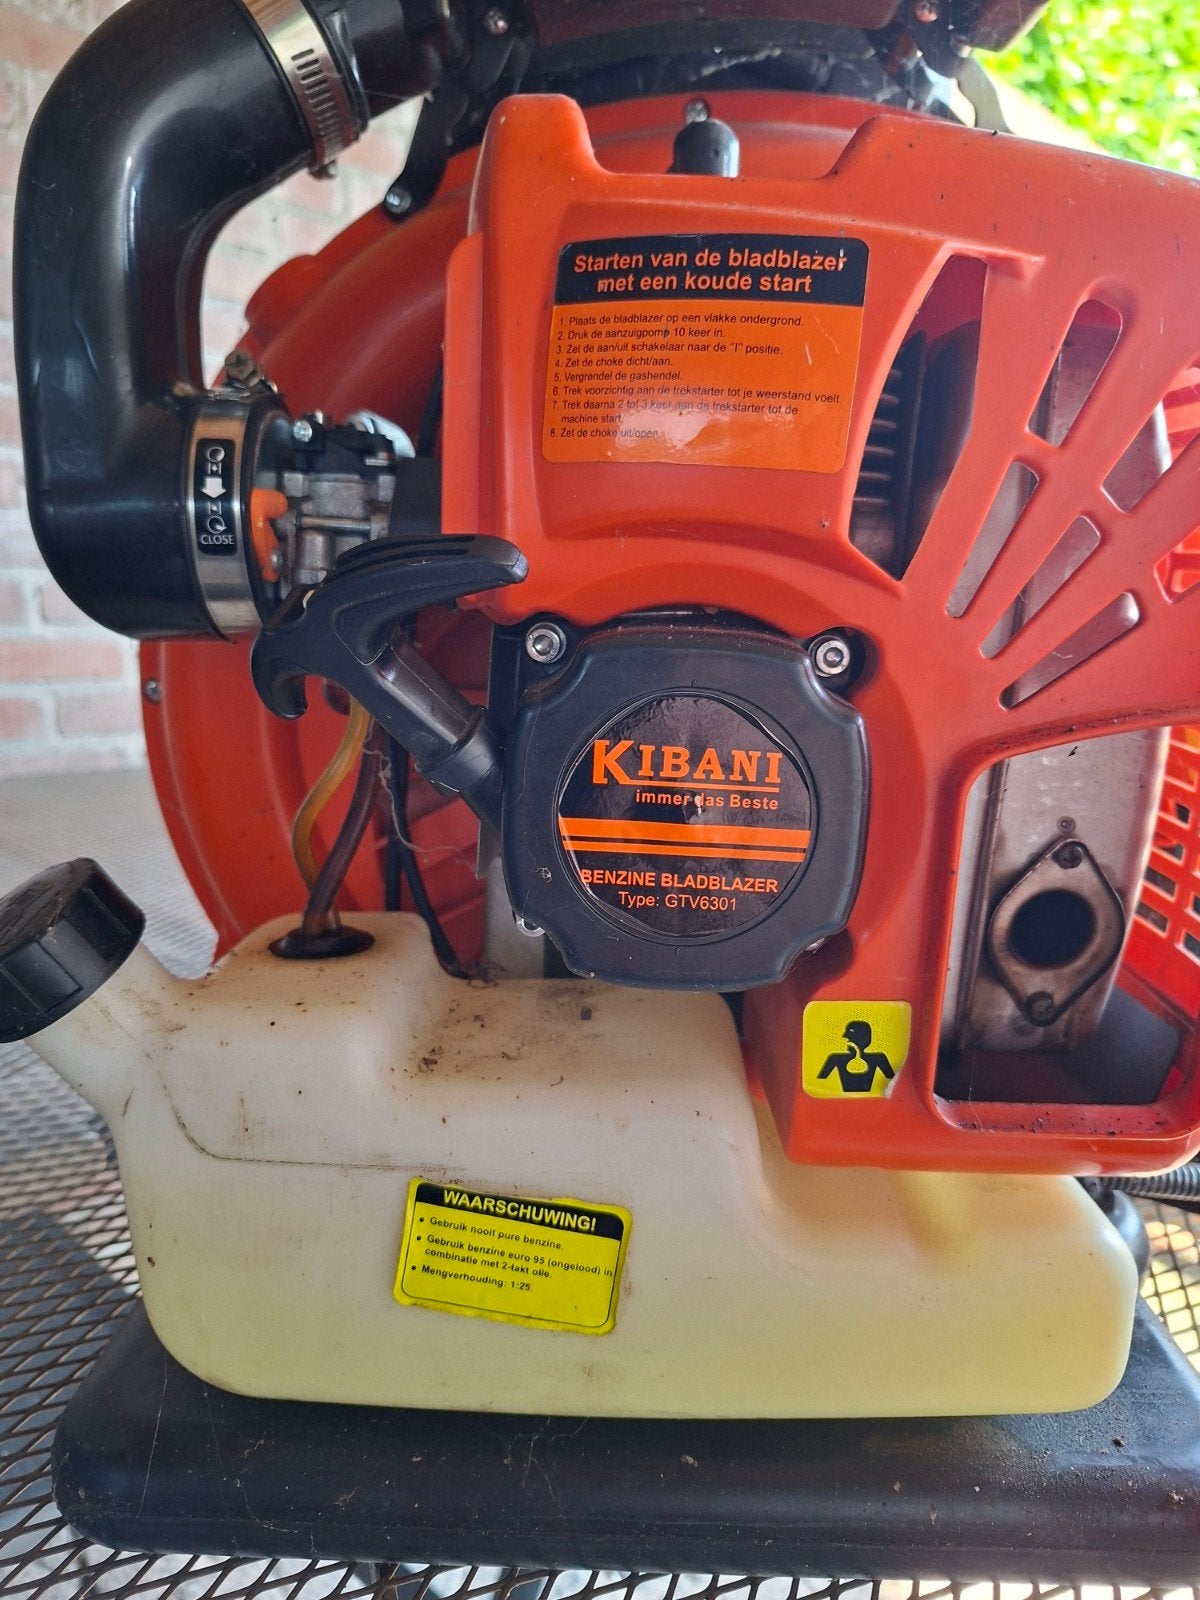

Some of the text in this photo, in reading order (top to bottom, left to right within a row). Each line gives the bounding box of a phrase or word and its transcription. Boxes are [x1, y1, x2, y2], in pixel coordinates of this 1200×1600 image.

[574, 248, 847, 272] Starten van de bladblazer
[597, 271, 812, 293] met een koude start
[560, 313, 804, 327] 1. Plaats de bladblazer op een vlakke ondergrond.
[557, 331, 565, 341] 2.
[568, 330, 588, 340] Druk
[591, 329, 602, 339] de
[674, 327, 685, 337] 10
[688, 327, 711, 337] keer
[713, 328, 726, 337] in.
[556, 345, 563, 355] 3.
[566, 344, 581, 354] Zet
[583, 343, 595, 353] de
[597, 342, 629, 353] aan/uit
[631, 341, 684, 352] schakelaar
[688, 343, 711, 352] naar
[713, 342, 727, 352] de
[745, 344, 783, 355] positie.
[565, 358, 580, 368] Zet
[582, 357, 593, 367] de
[596, 356, 624, 367] choke
[626, 356, 673, 367] dicht/aan.
[564, 371, 613, 383] Vergrendel
[615, 371, 627, 380] de
[629, 370, 683, 382] gashendel.
[563, 386, 582, 396] Trek
[585, 385, 634, 397] voorzichtig
[636, 387, 655, 396] aan
[657, 385, 671, 395] de
[673, 385, 724, 397] trekstarter
[727, 388, 741, 397] tot
[743, 388, 753, 399] je
[756, 389, 812, 401] weerstand
[552, 400, 560, 410] 7.
[563, 400, 581, 410] Trek
[618, 400, 624, 410] 2
[626, 400, 639, 410] tot
[641, 400, 648, 410] 3
[650, 399, 672, 410] keer
[675, 401, 694, 411] aan
[696, 401, 710, 411] de
[713, 402, 766, 414] trekstarter
[768, 404, 781, 415] tot
[784, 404, 799, 415] de
[561, 414, 599, 424] machine
[550, 428, 558, 438] 8.
[560, 427, 575, 438] Zet
[577, 427, 589, 437] de
[590, 427, 618, 437] choke
[200, 534, 235, 545] CLOSE
[592, 739, 783, 785] KIBANI
[635, 789, 689, 805] immer
[729, 795, 779, 810] Beste
[581, 868, 779, 893] BENZINE BLADBLAZER
[618, 891, 736, 911] Type: GTV6301
[443, 1189, 597, 1231] WAARSCHUWING!
[430, 1216, 564, 1250] Gebruik nooit pure benzine.
[425, 1248, 552, 1278] combinatie met 2-takt olie.
[427, 1234, 613, 1277] Gebruik benzine euro 95 (ongelood) in
[421, 1264, 507, 1288] Mengverhouding:
